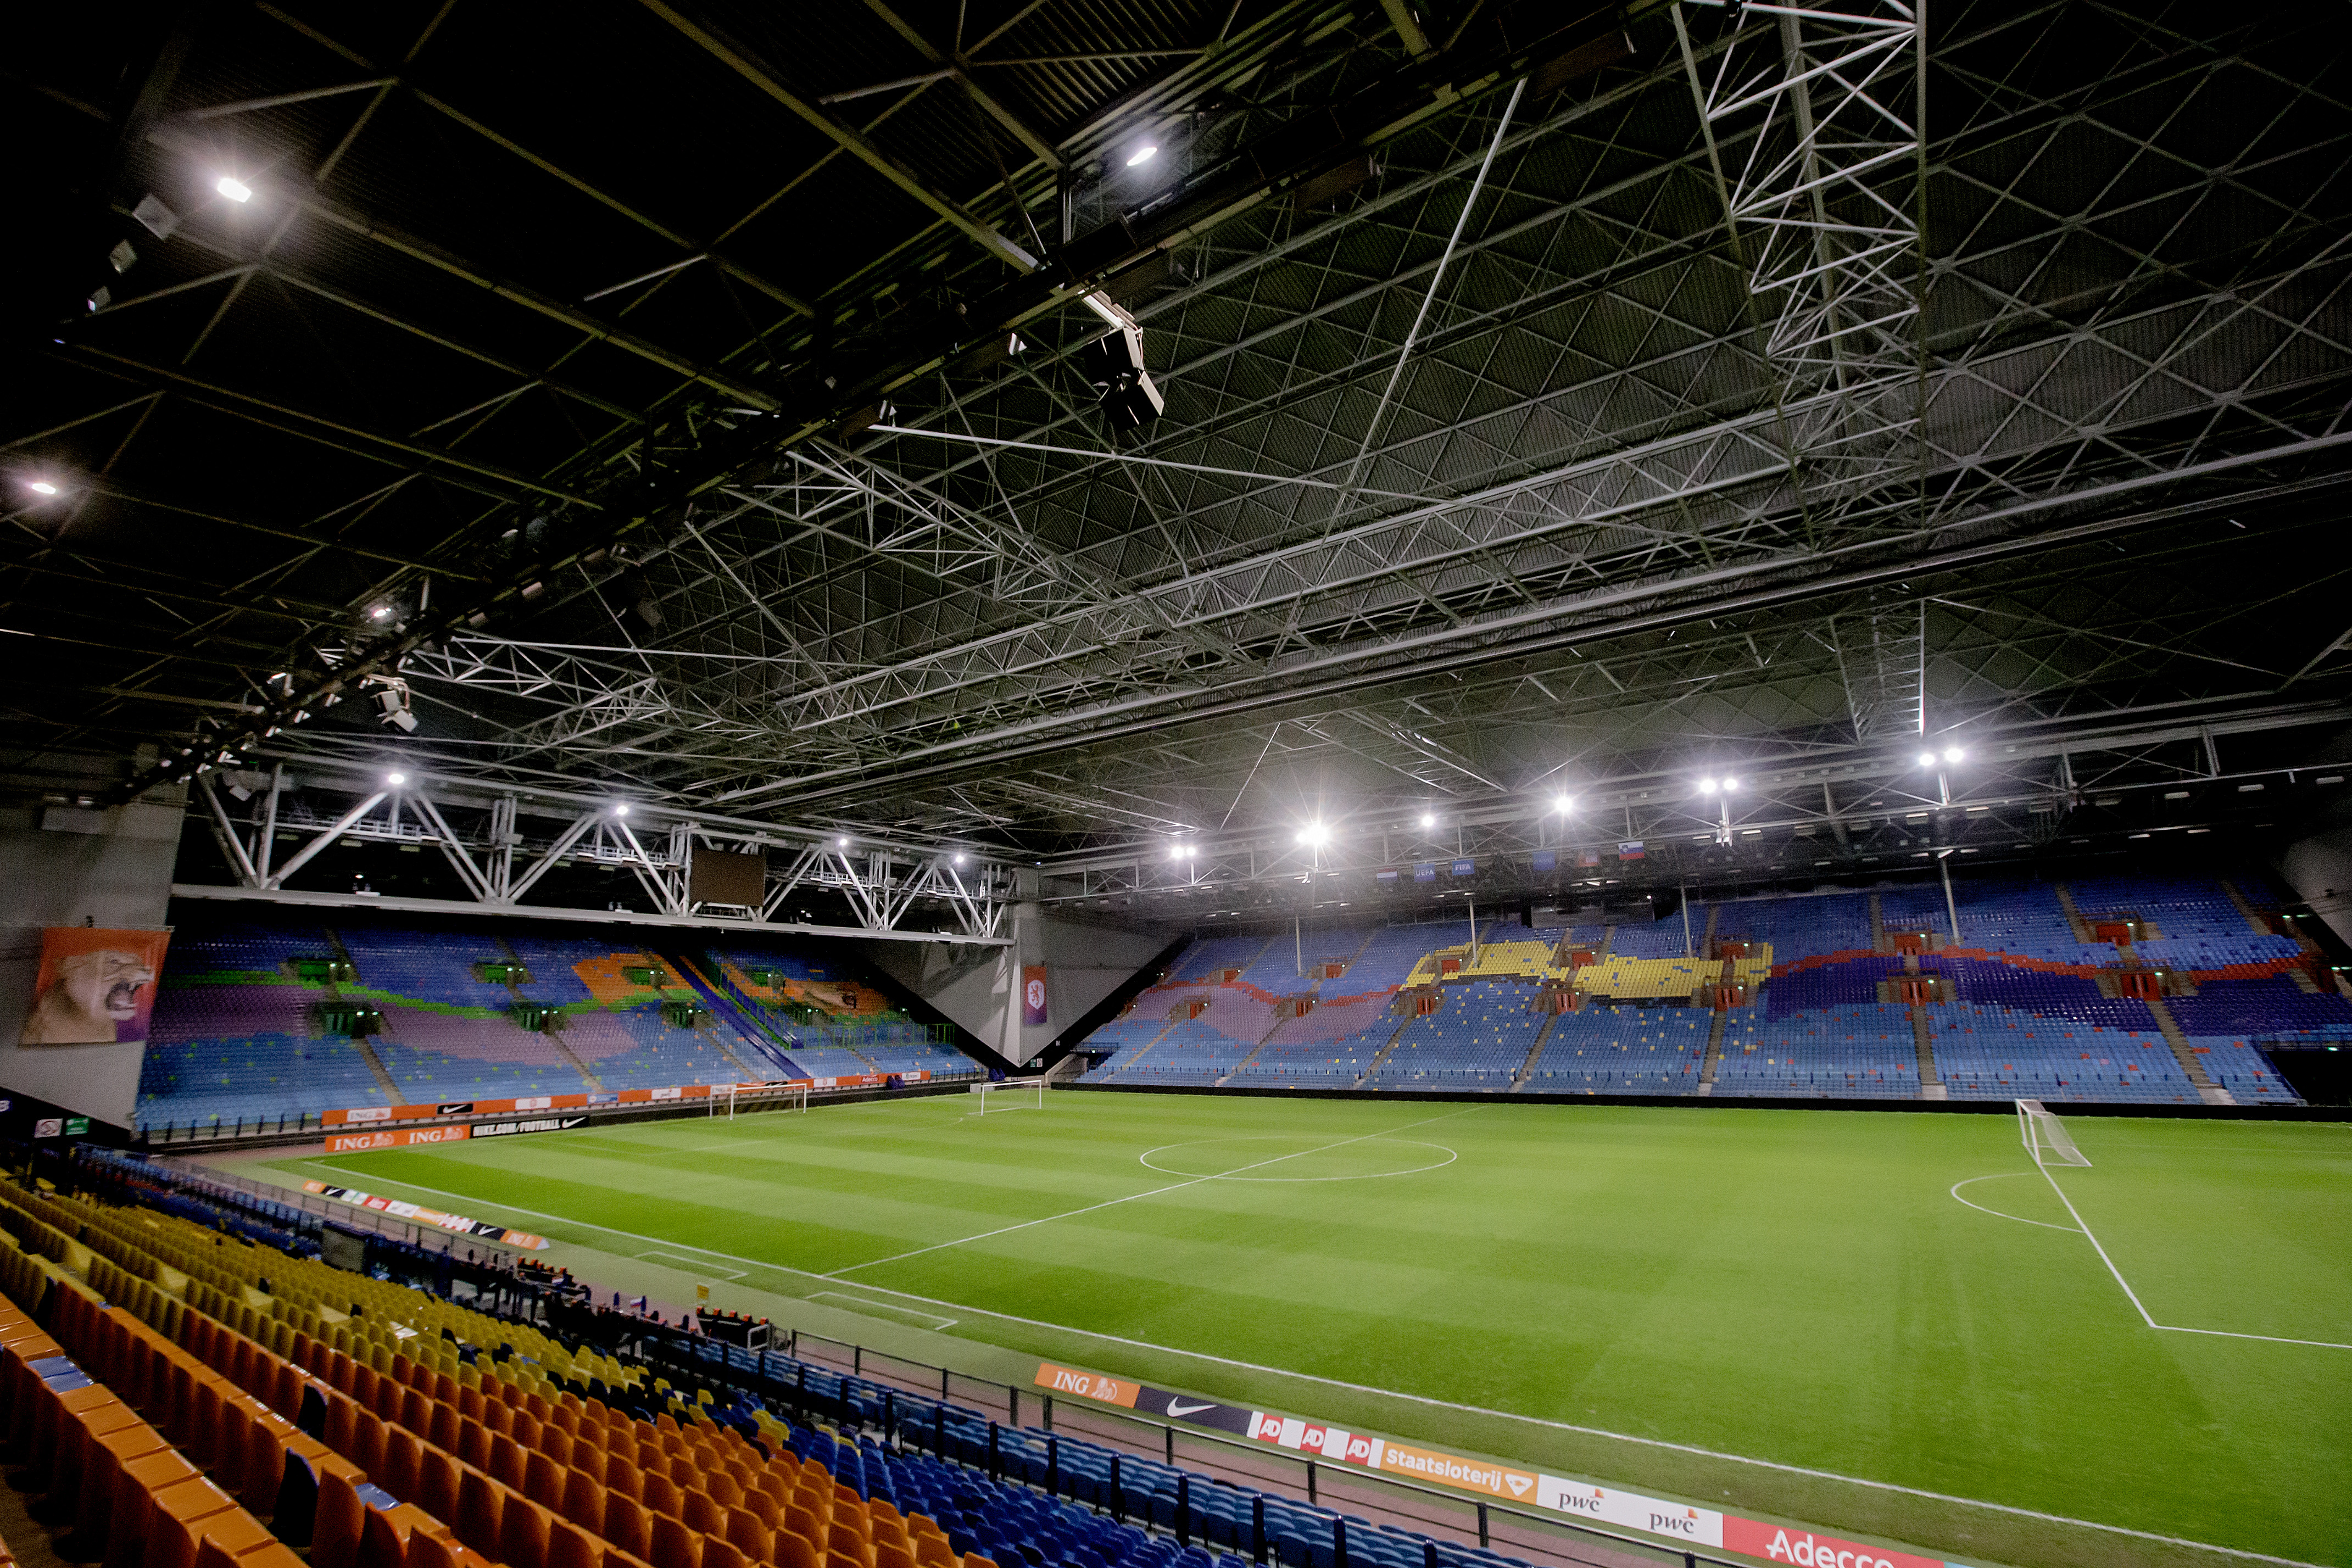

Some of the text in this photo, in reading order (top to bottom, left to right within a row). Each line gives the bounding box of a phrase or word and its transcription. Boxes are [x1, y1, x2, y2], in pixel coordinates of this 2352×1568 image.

[334, 1137, 370, 1151] ING
[409, 1130, 442, 1144] ING
[1053, 1371, 1090, 1395] ING
[1260, 1419, 1281, 1438] AD
[1303, 1428, 1324, 1447] AD
[1347, 1439, 1370, 1458] AD
[1559, 1492, 1600, 1512] pwc
[1649, 1512, 1695, 1533] pwc
